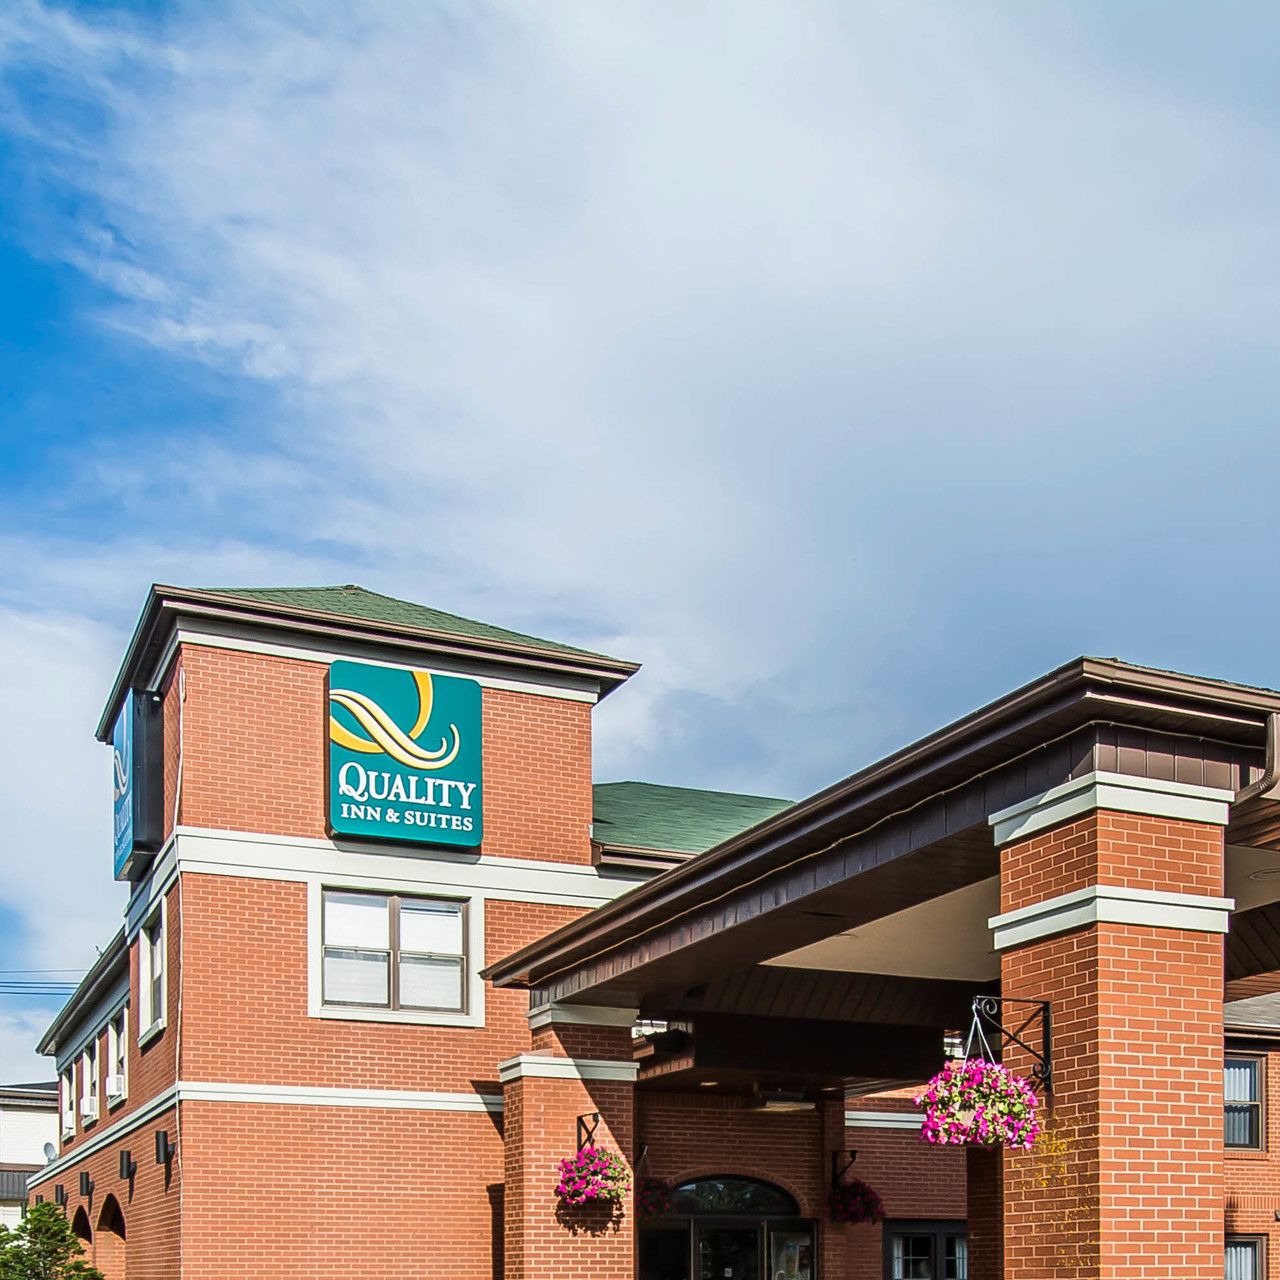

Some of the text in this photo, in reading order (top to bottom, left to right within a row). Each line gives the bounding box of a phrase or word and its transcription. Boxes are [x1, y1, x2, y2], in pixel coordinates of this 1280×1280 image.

[338, 761, 477, 810] QUALITY
[340, 803, 474, 832] INN & SUITES
